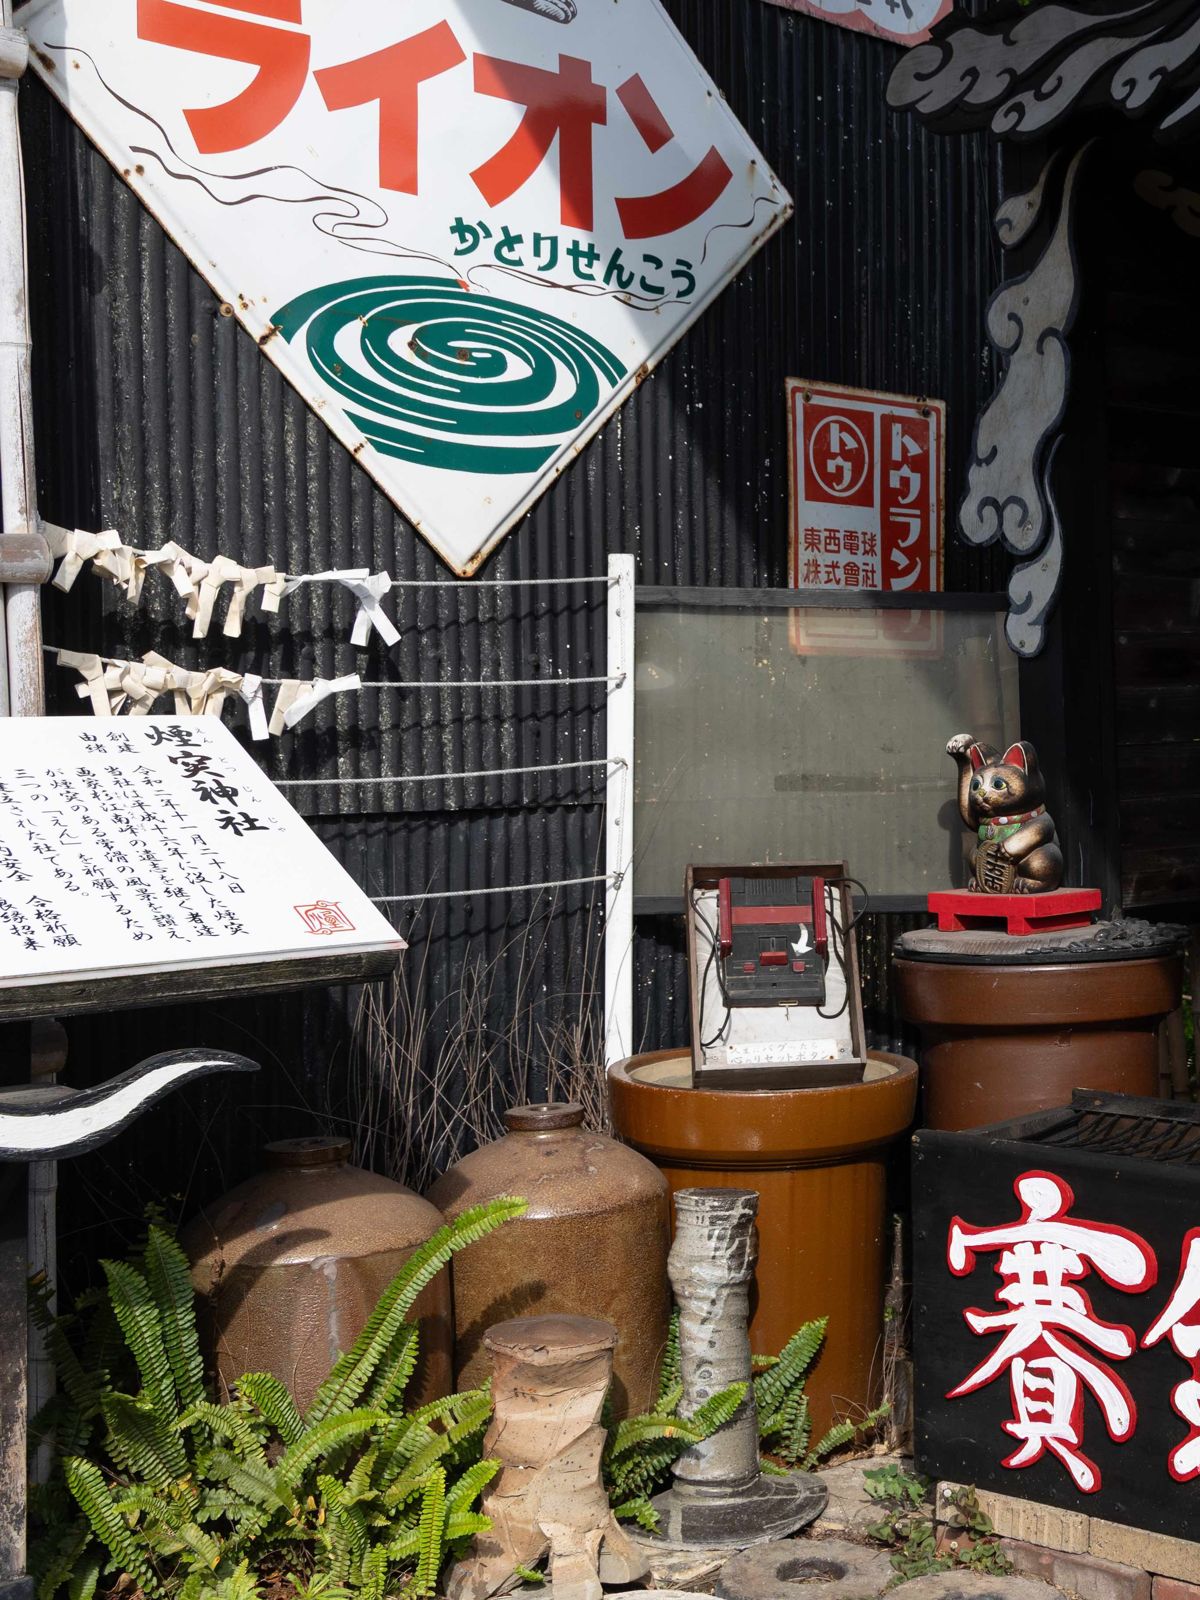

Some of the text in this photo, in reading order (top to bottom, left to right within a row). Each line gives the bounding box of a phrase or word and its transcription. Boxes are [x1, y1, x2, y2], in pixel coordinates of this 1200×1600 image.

[137, 0, 732, 240] ライオン
[449, 216, 697, 299] かとりせんこう
[803, 527, 878, 556] 東西電球
[889, 422, 924, 632] トウラン
[803, 559, 878, 588] 株式會社
[79, 732, 107, 753] 由緒
[106, 731, 141, 753] 創建
[144, 725, 270, 837] 煙突神社
